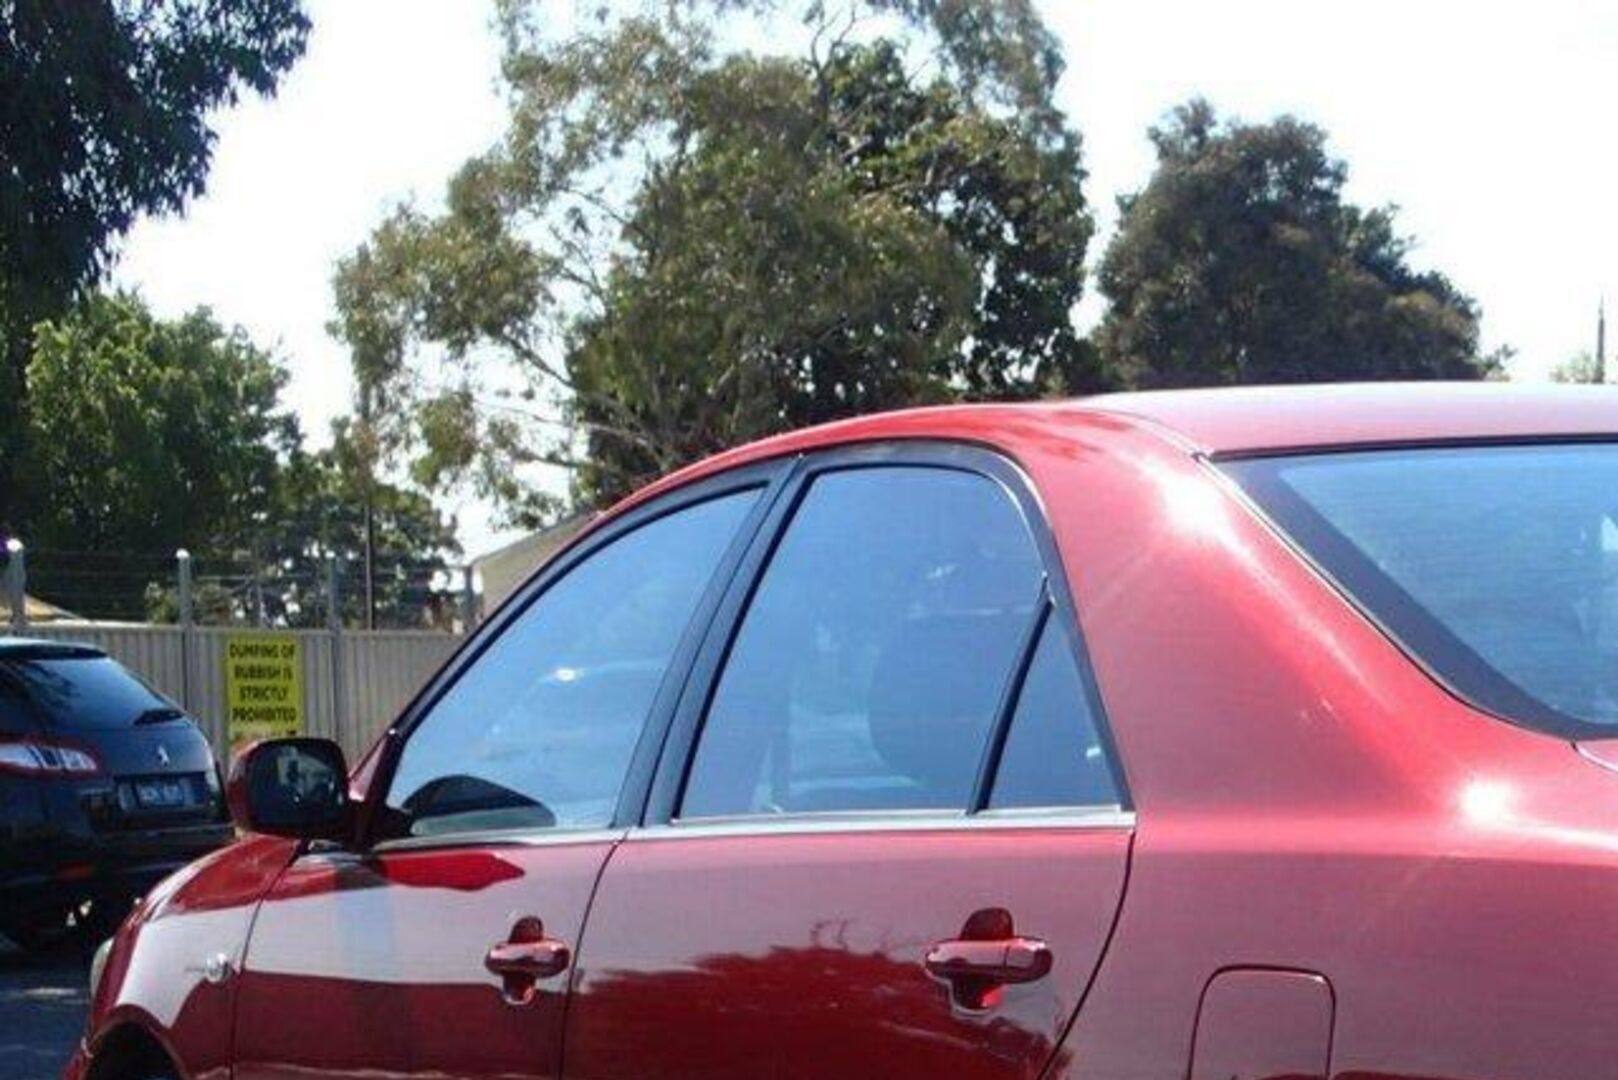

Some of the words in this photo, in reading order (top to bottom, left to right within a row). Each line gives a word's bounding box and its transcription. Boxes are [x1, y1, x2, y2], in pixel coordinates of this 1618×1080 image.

[230, 644, 279, 658] DUMPING
[234, 665, 281, 679] RUBBISH
[240, 685, 288, 701] STRICTLY
[231, 707, 297, 722] PROHIBITED
